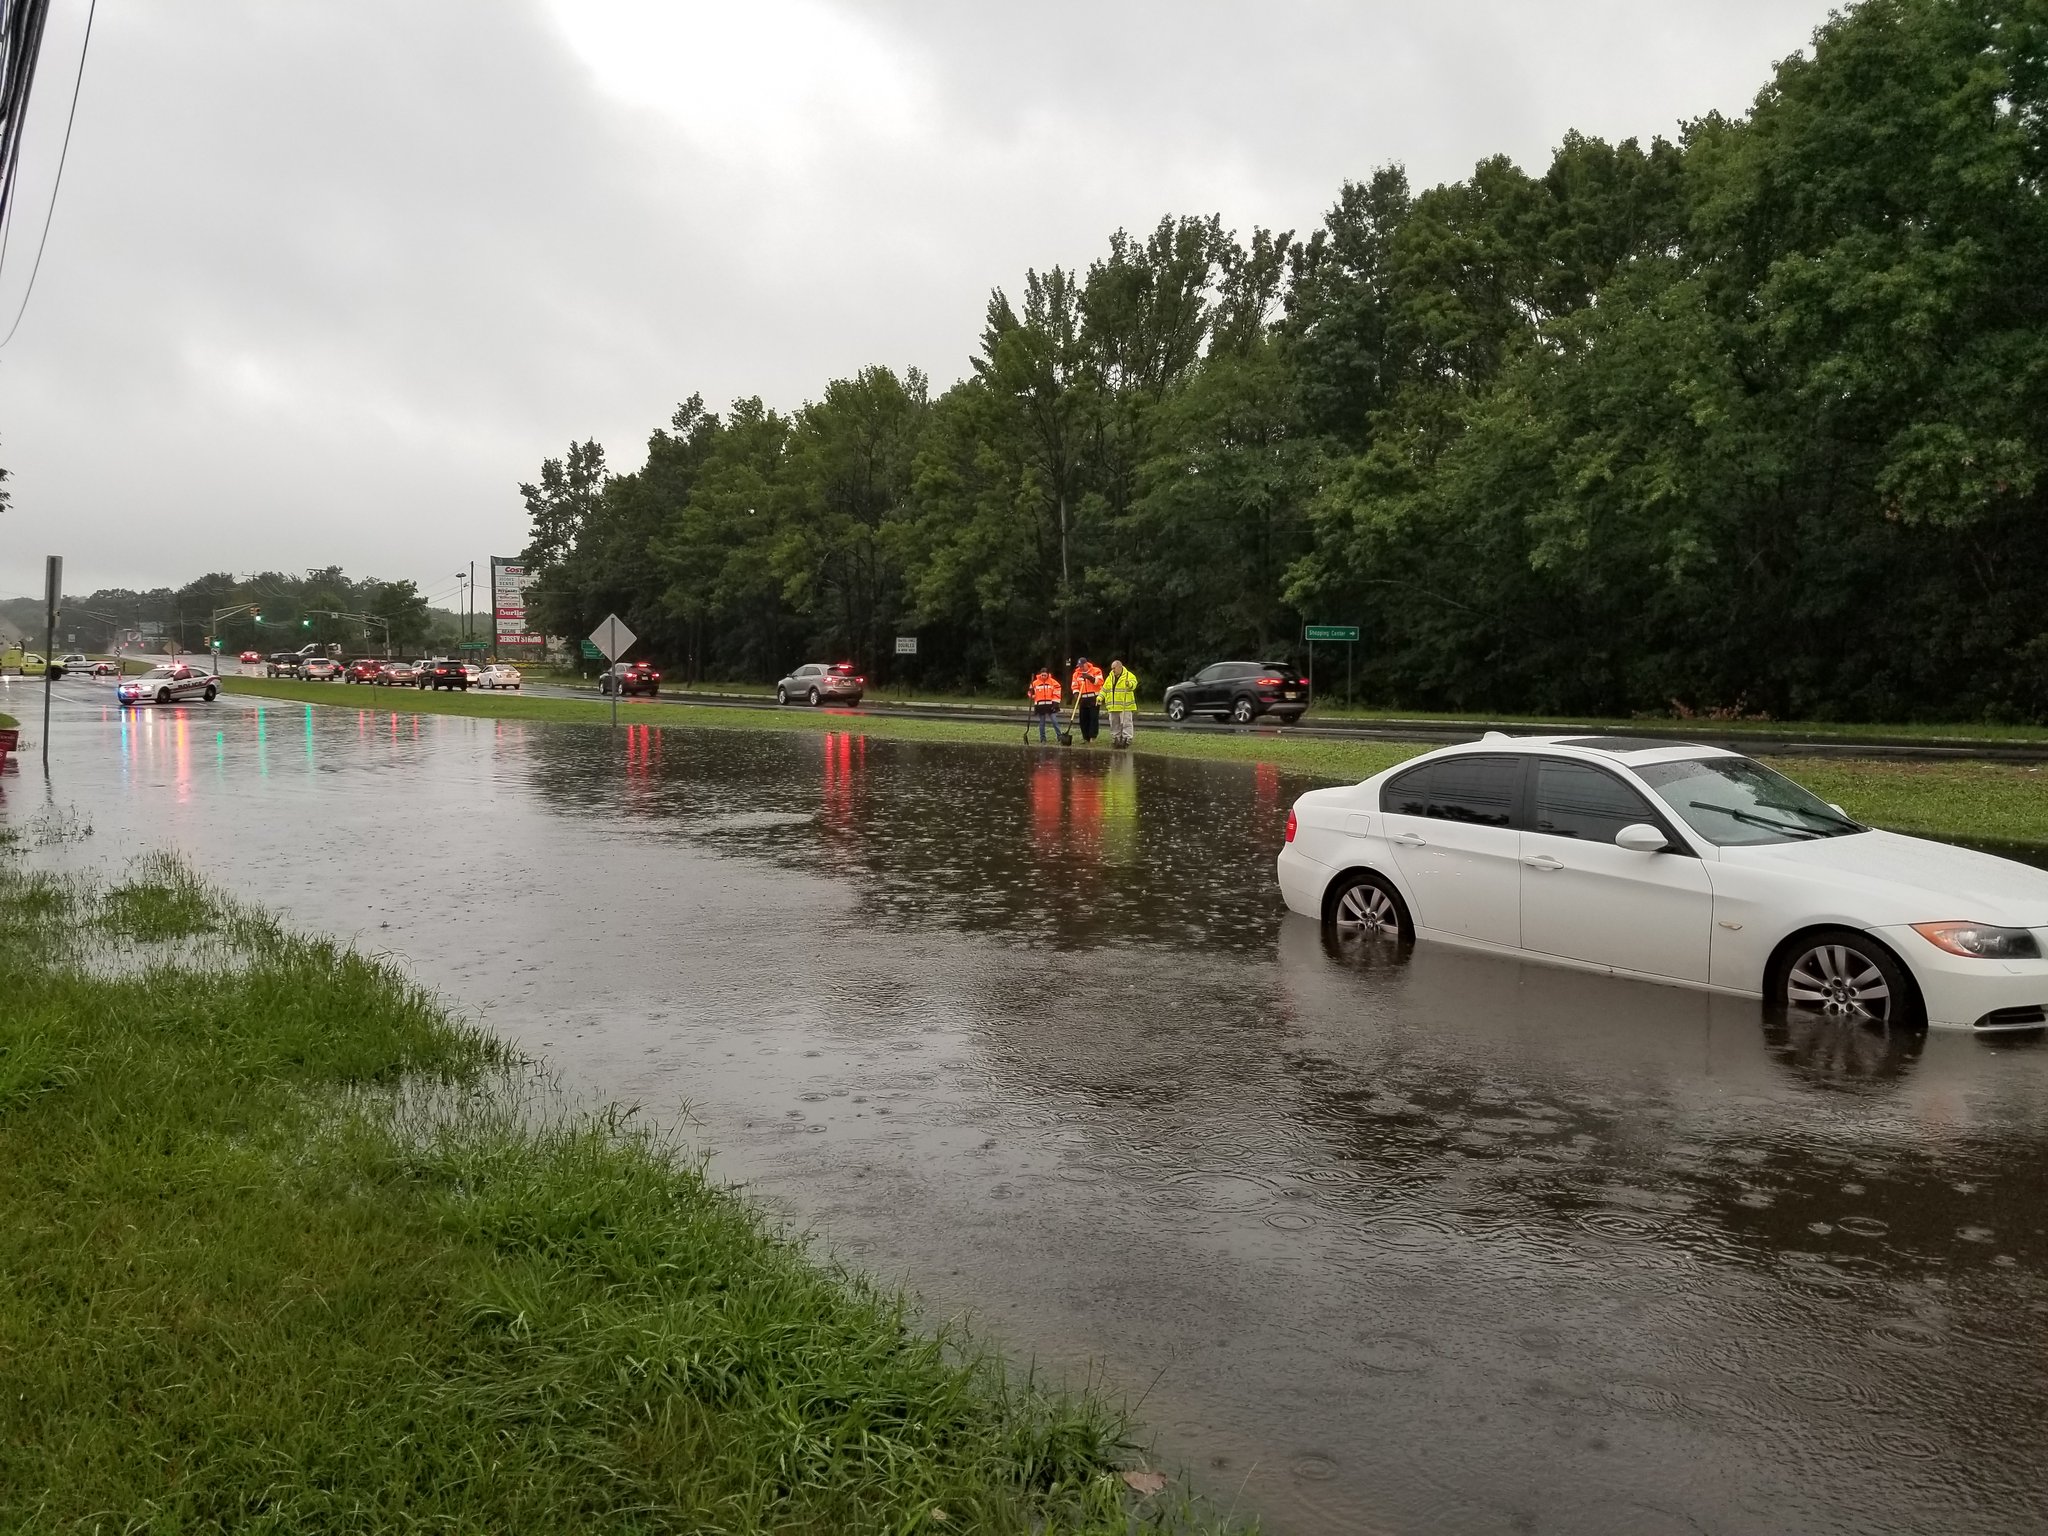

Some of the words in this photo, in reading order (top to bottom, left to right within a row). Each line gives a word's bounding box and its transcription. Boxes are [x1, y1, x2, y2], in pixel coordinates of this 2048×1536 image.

[499, 635, 520, 643] JERSEY
[520, 635, 542, 643] STRONG
[178, 681, 202, 689] POLICE
